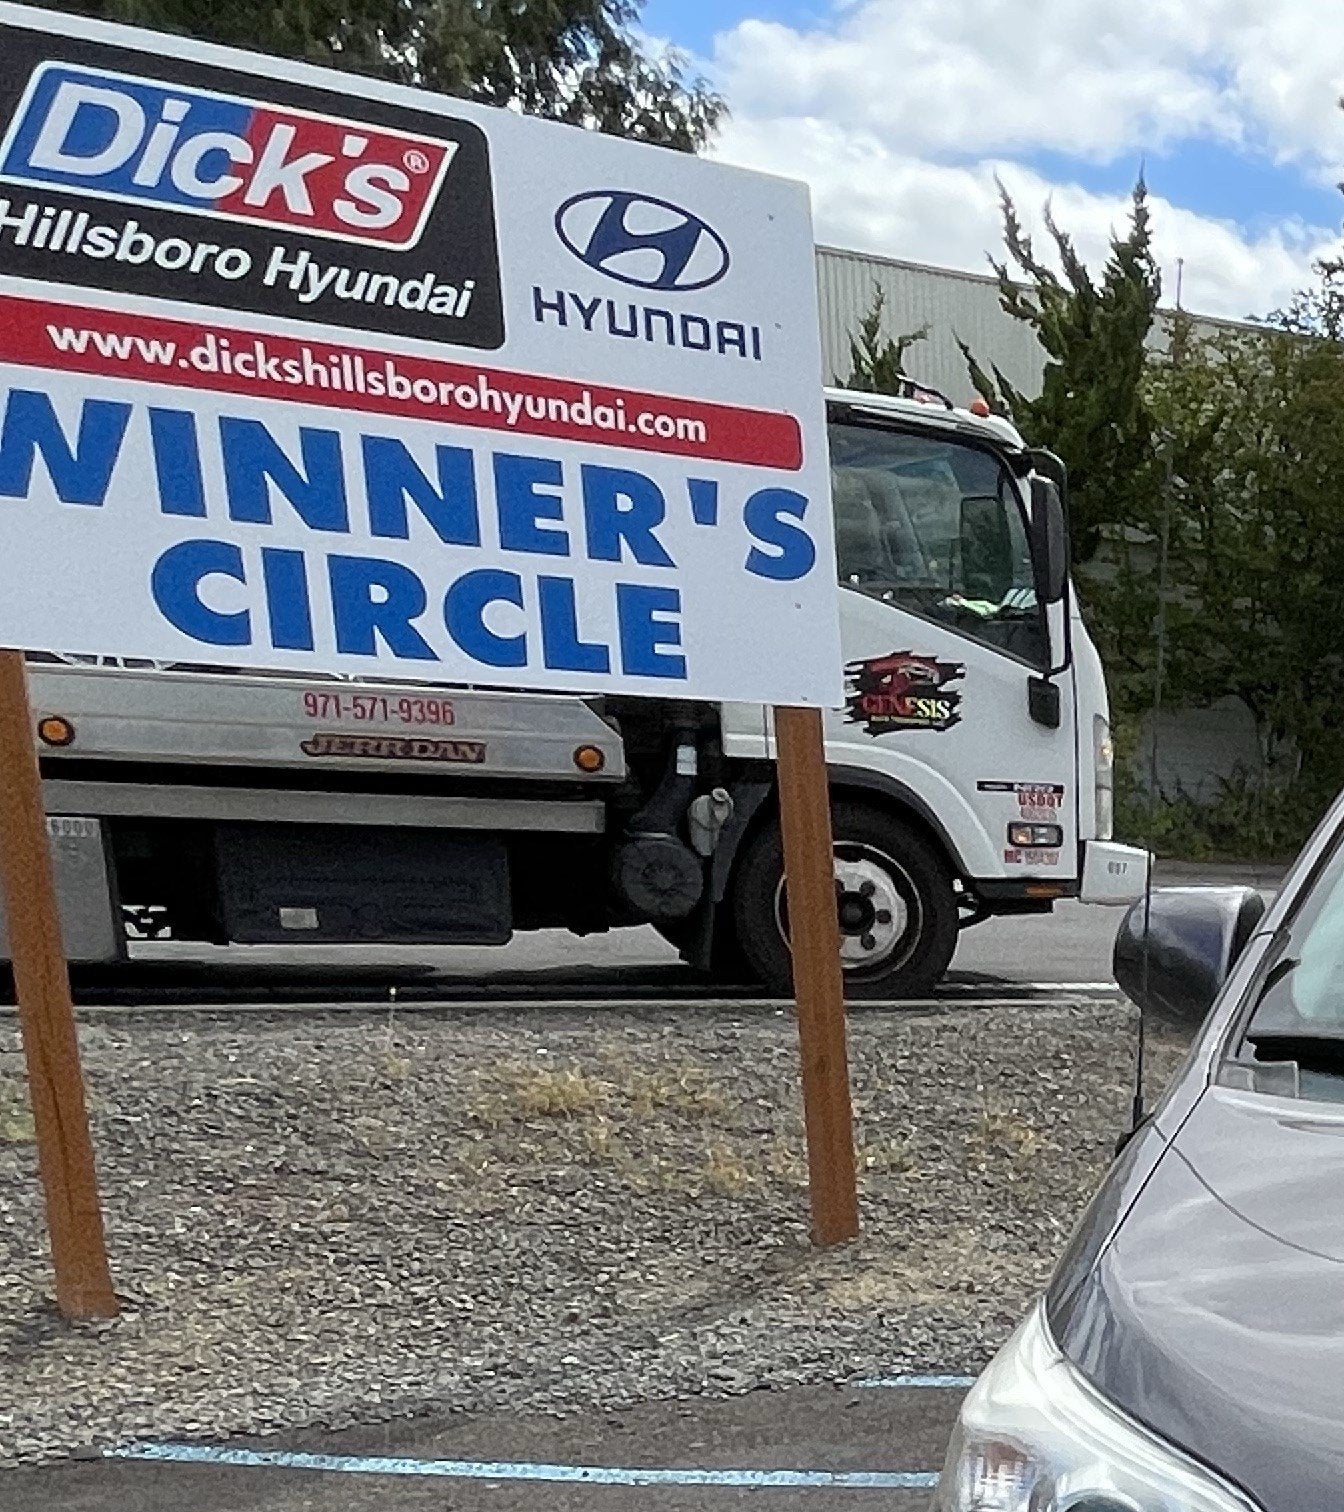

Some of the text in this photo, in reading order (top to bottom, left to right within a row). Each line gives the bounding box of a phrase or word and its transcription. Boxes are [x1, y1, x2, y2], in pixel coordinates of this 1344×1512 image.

[0, 199, 476, 319] Hillsboro Hyundai
[532, 285, 763, 362] HYUNDAI
[47, 324, 707, 443] www.dickshillsborohyundai.com
[0, 389, 817, 581] WINNER'S
[151, 539, 689, 681] CIRCLE
[304, 691, 456, 726] 971-571-9396
